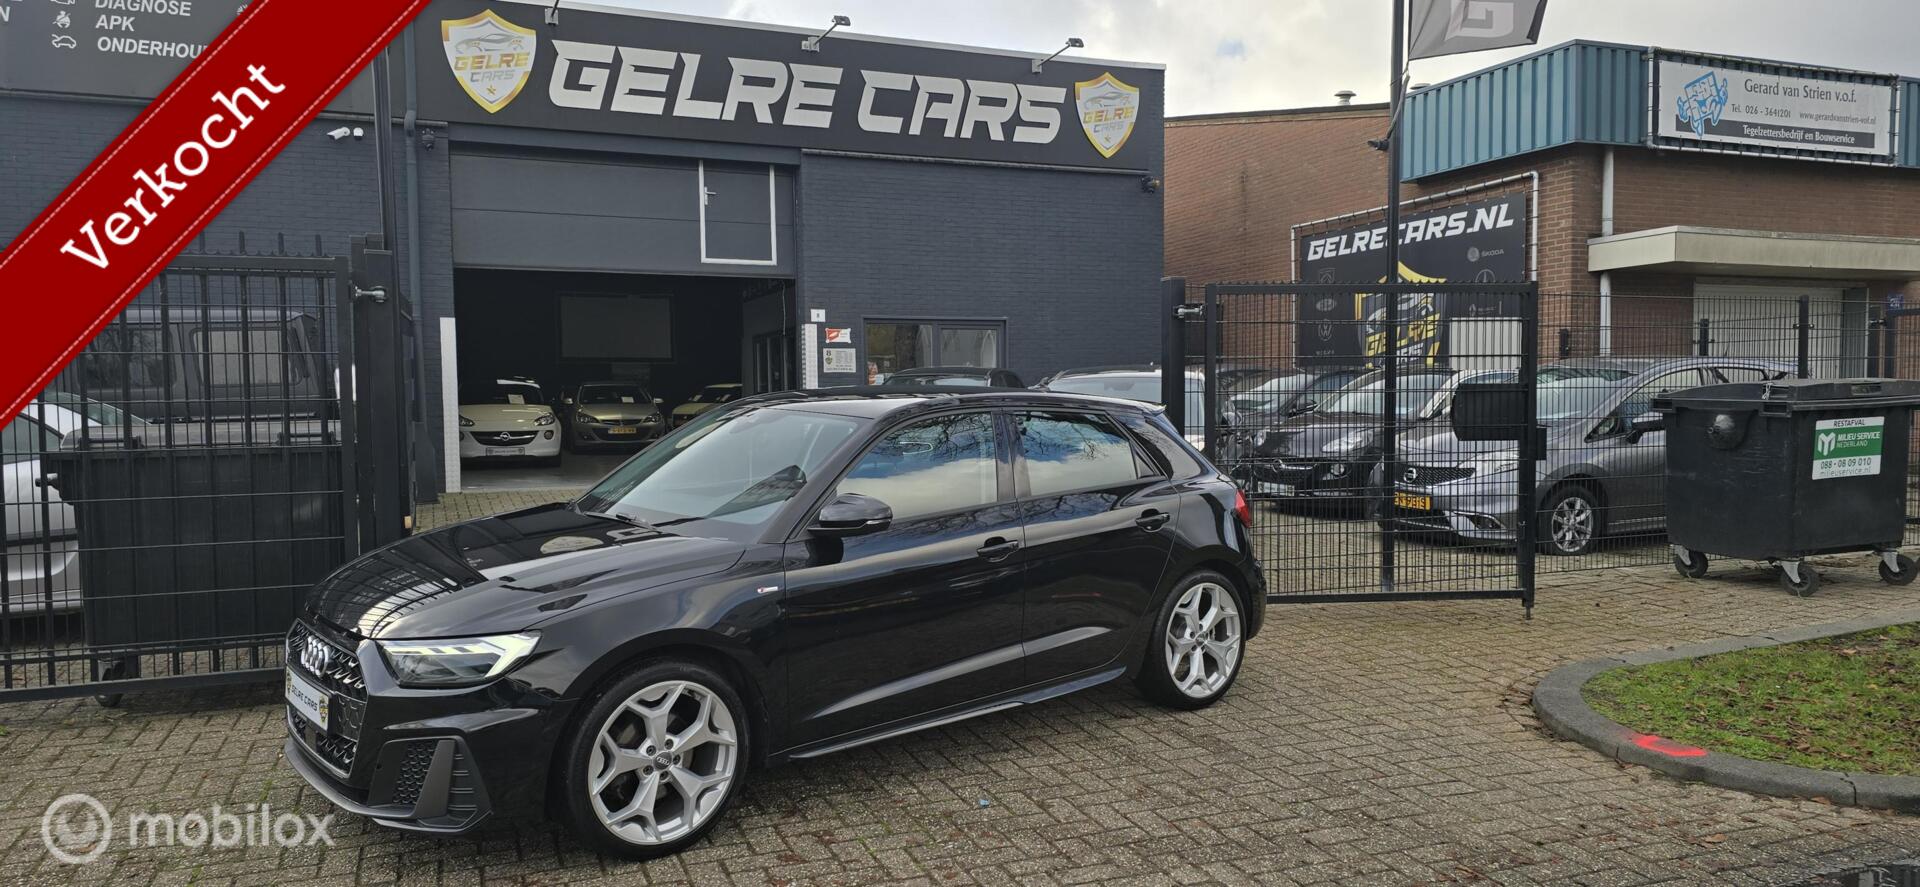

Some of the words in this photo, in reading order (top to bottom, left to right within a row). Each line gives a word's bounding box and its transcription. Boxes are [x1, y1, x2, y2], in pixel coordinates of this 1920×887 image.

[95, 0, 192, 17] DIAGNOSE
[95, 14, 136, 32] APK
[97, 36, 208, 59] ONDERHOU
[454, 52, 530, 71] GELRE
[470, 69, 515, 82] CARS
[549, 39, 843, 128] GELRE
[857, 69, 1067, 144] CARS
[1744, 79, 1780, 96] Gerard
[1782, 86, 1800, 98] van
[1803, 85, 1832, 102] Strien
[1835, 89, 1857, 103] v.o.f.
[1083, 106, 1135, 124] GELRE
[1731, 104, 1742, 113] Tel.
[1745, 105, 1758, 115] 026
[1764, 107, 1791, 118] 3641201
[1743, 124, 1804, 141] Tegelzettersbedrijf
[1805, 131, 1814, 140] en
[1815, 132, 1856, 144] Bouwservice
[1833, 419, 1866, 428] RESTAFVAL
[1836, 440, 1868, 449] NEDERLAND
[1837, 432, 1857, 442] MILIEU
[1857, 431, 1880, 440] SERVICE
[1838, 459, 1847, 468] 08
[1848, 458, 1857, 467] 09
[1858, 457, 1872, 466] 010
[1820, 466, 1871, 477] milieuservice.nl
